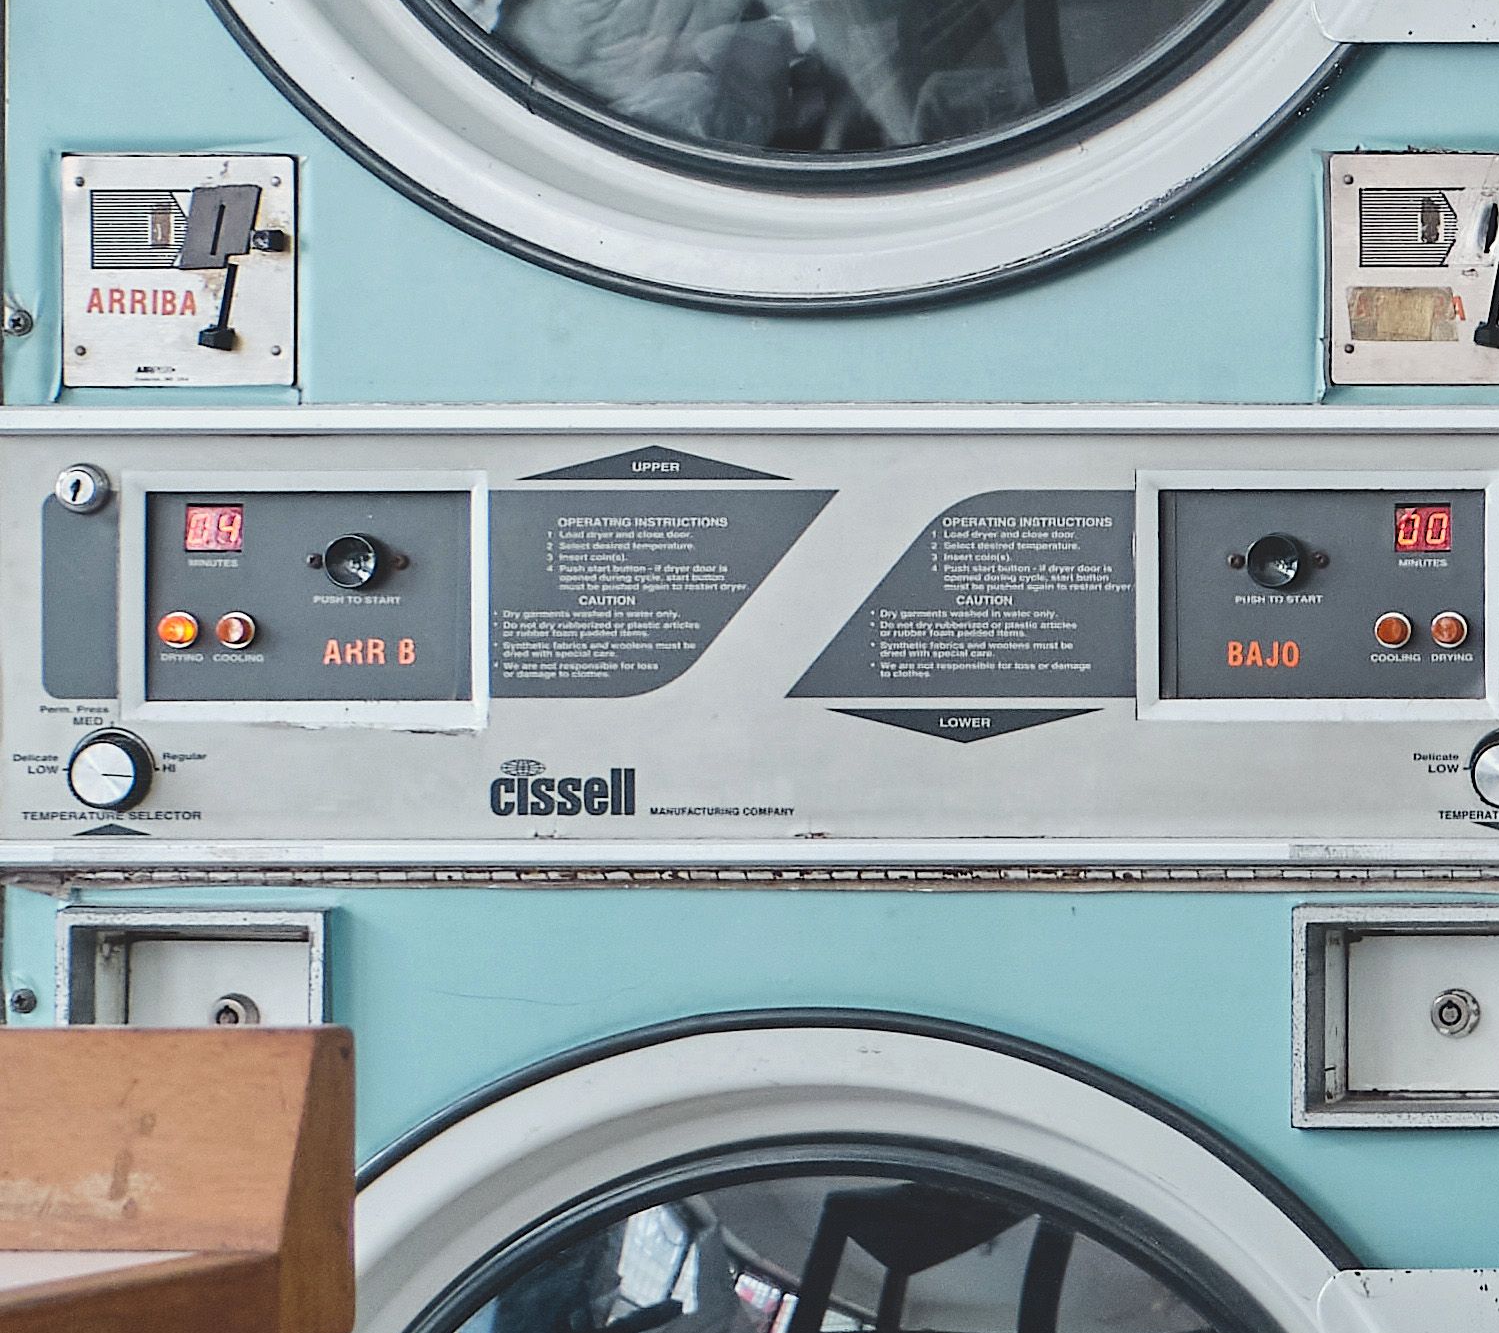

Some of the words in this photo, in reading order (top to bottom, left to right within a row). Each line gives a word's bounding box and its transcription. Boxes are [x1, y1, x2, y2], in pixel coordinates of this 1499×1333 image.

[87, 288, 196, 315] ARRIBA
[631, 461, 681, 472] UPPER
[558, 517, 631, 527] OPERATING
[635, 517, 728, 527] INSTRUCTIONS
[943, 517, 1016, 527] OPERATING
[1020, 517, 1112, 527] INSTRUCTIONS
[1399, 511, 1448, 545] 00
[1399, 559, 1448, 567] MINUTES
[313, 596, 343, 604] PUSH
[346, 596, 363, 604] TO
[364, 596, 400, 604] START
[579, 595, 636, 605] CAUTION
[957, 595, 1012, 605] CAUTION
[1235, 595, 1265, 604] PUSH
[1268, 595, 1284, 604] TO
[1286, 595, 1323, 604] START
[161, 653, 204, 662] DRYING
[213, 653, 264, 662] COOLING
[1227, 642, 1300, 667] BAJO
[1370, 653, 1421, 661] COOLING
[1431, 653, 1473, 661] DRYING
[40, 706, 74, 714] Perm.
[79, 706, 109, 714] Press
[73, 716, 104, 726] MED
[940, 717, 990, 727] LOWER
[13, 753, 58, 762] Delicate
[163, 752, 206, 761] Regular
[1413, 753, 1458, 761] Delicate
[28, 764, 58, 774] LOW
[163, 764, 176, 772] HI
[1428, 764, 1459, 773] LOW
[22, 811, 125, 821] TEMPERATURE
[129, 811, 201, 821] SELECTOR
[650, 807, 740, 816] MANUFACTURING
[742, 807, 794, 816] COMPANY
